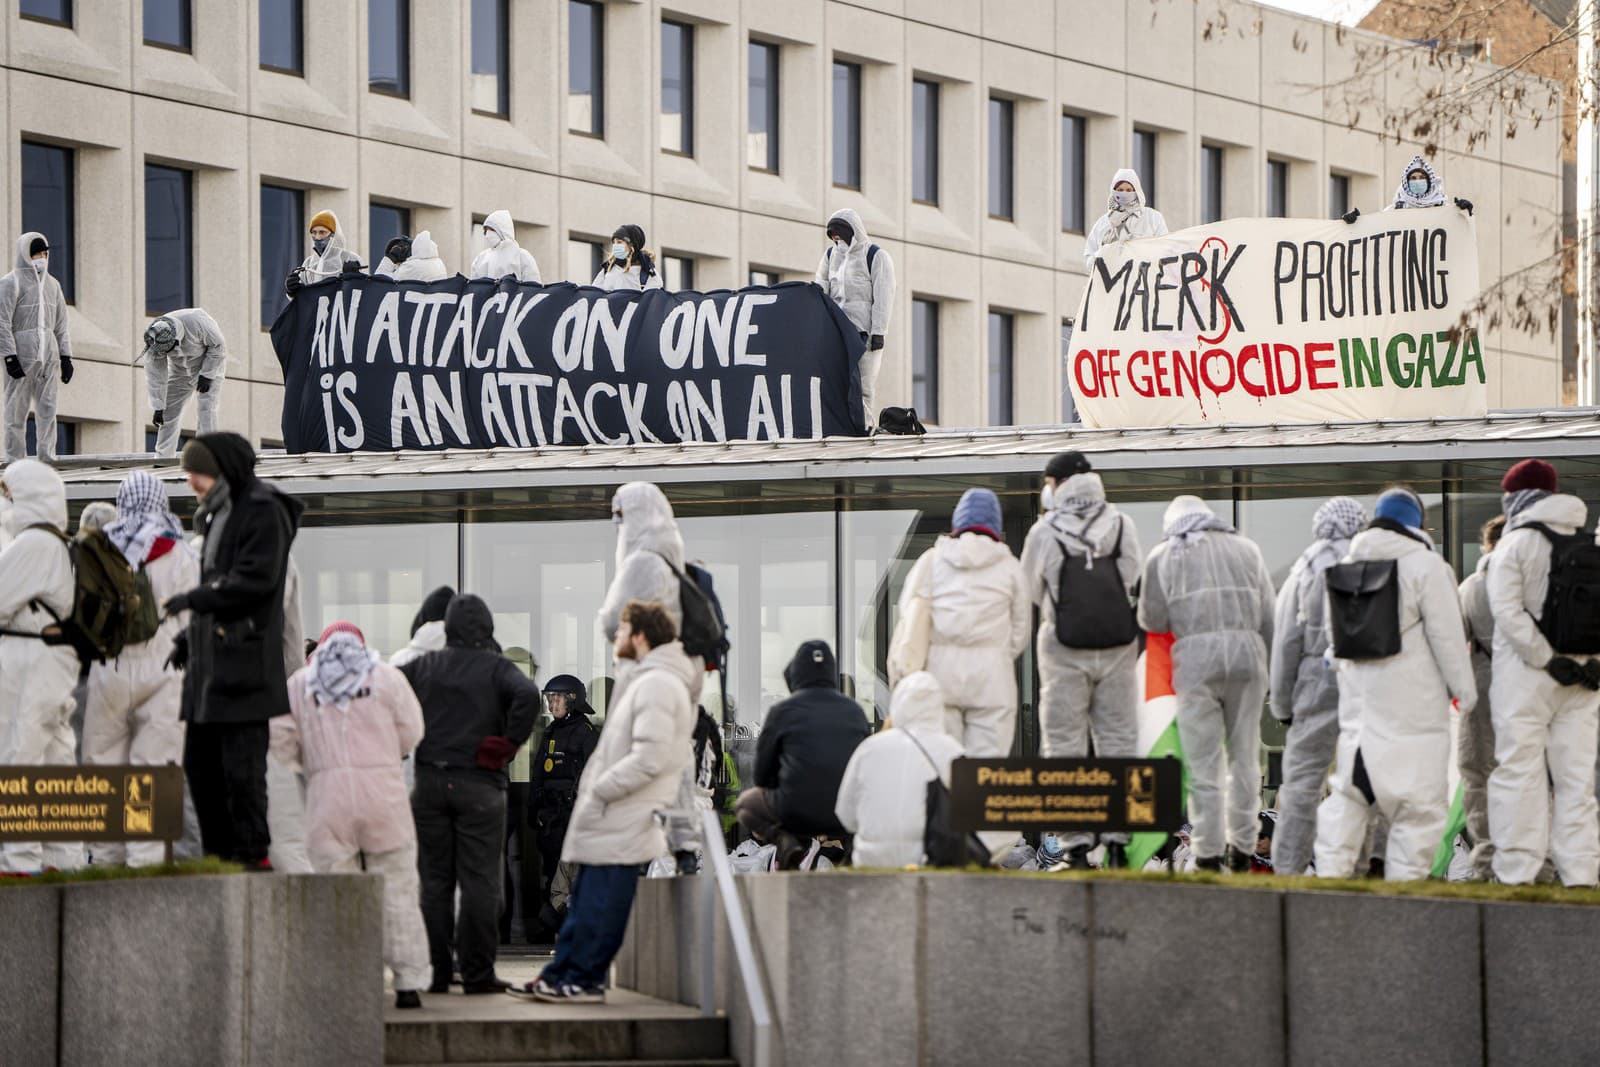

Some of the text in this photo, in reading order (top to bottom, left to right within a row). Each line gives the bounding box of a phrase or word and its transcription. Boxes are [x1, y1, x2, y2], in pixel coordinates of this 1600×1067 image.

[1274, 228, 1450, 325] PROFITTING
[311, 289, 778, 372] AN ATTACK ON ONE
[1074, 328, 1486, 399] OFF GENOCIDE IN GAZA
[391, 373, 473, 447] AN
[481, 373, 662, 447] ATTACK
[666, 379, 727, 443] ON
